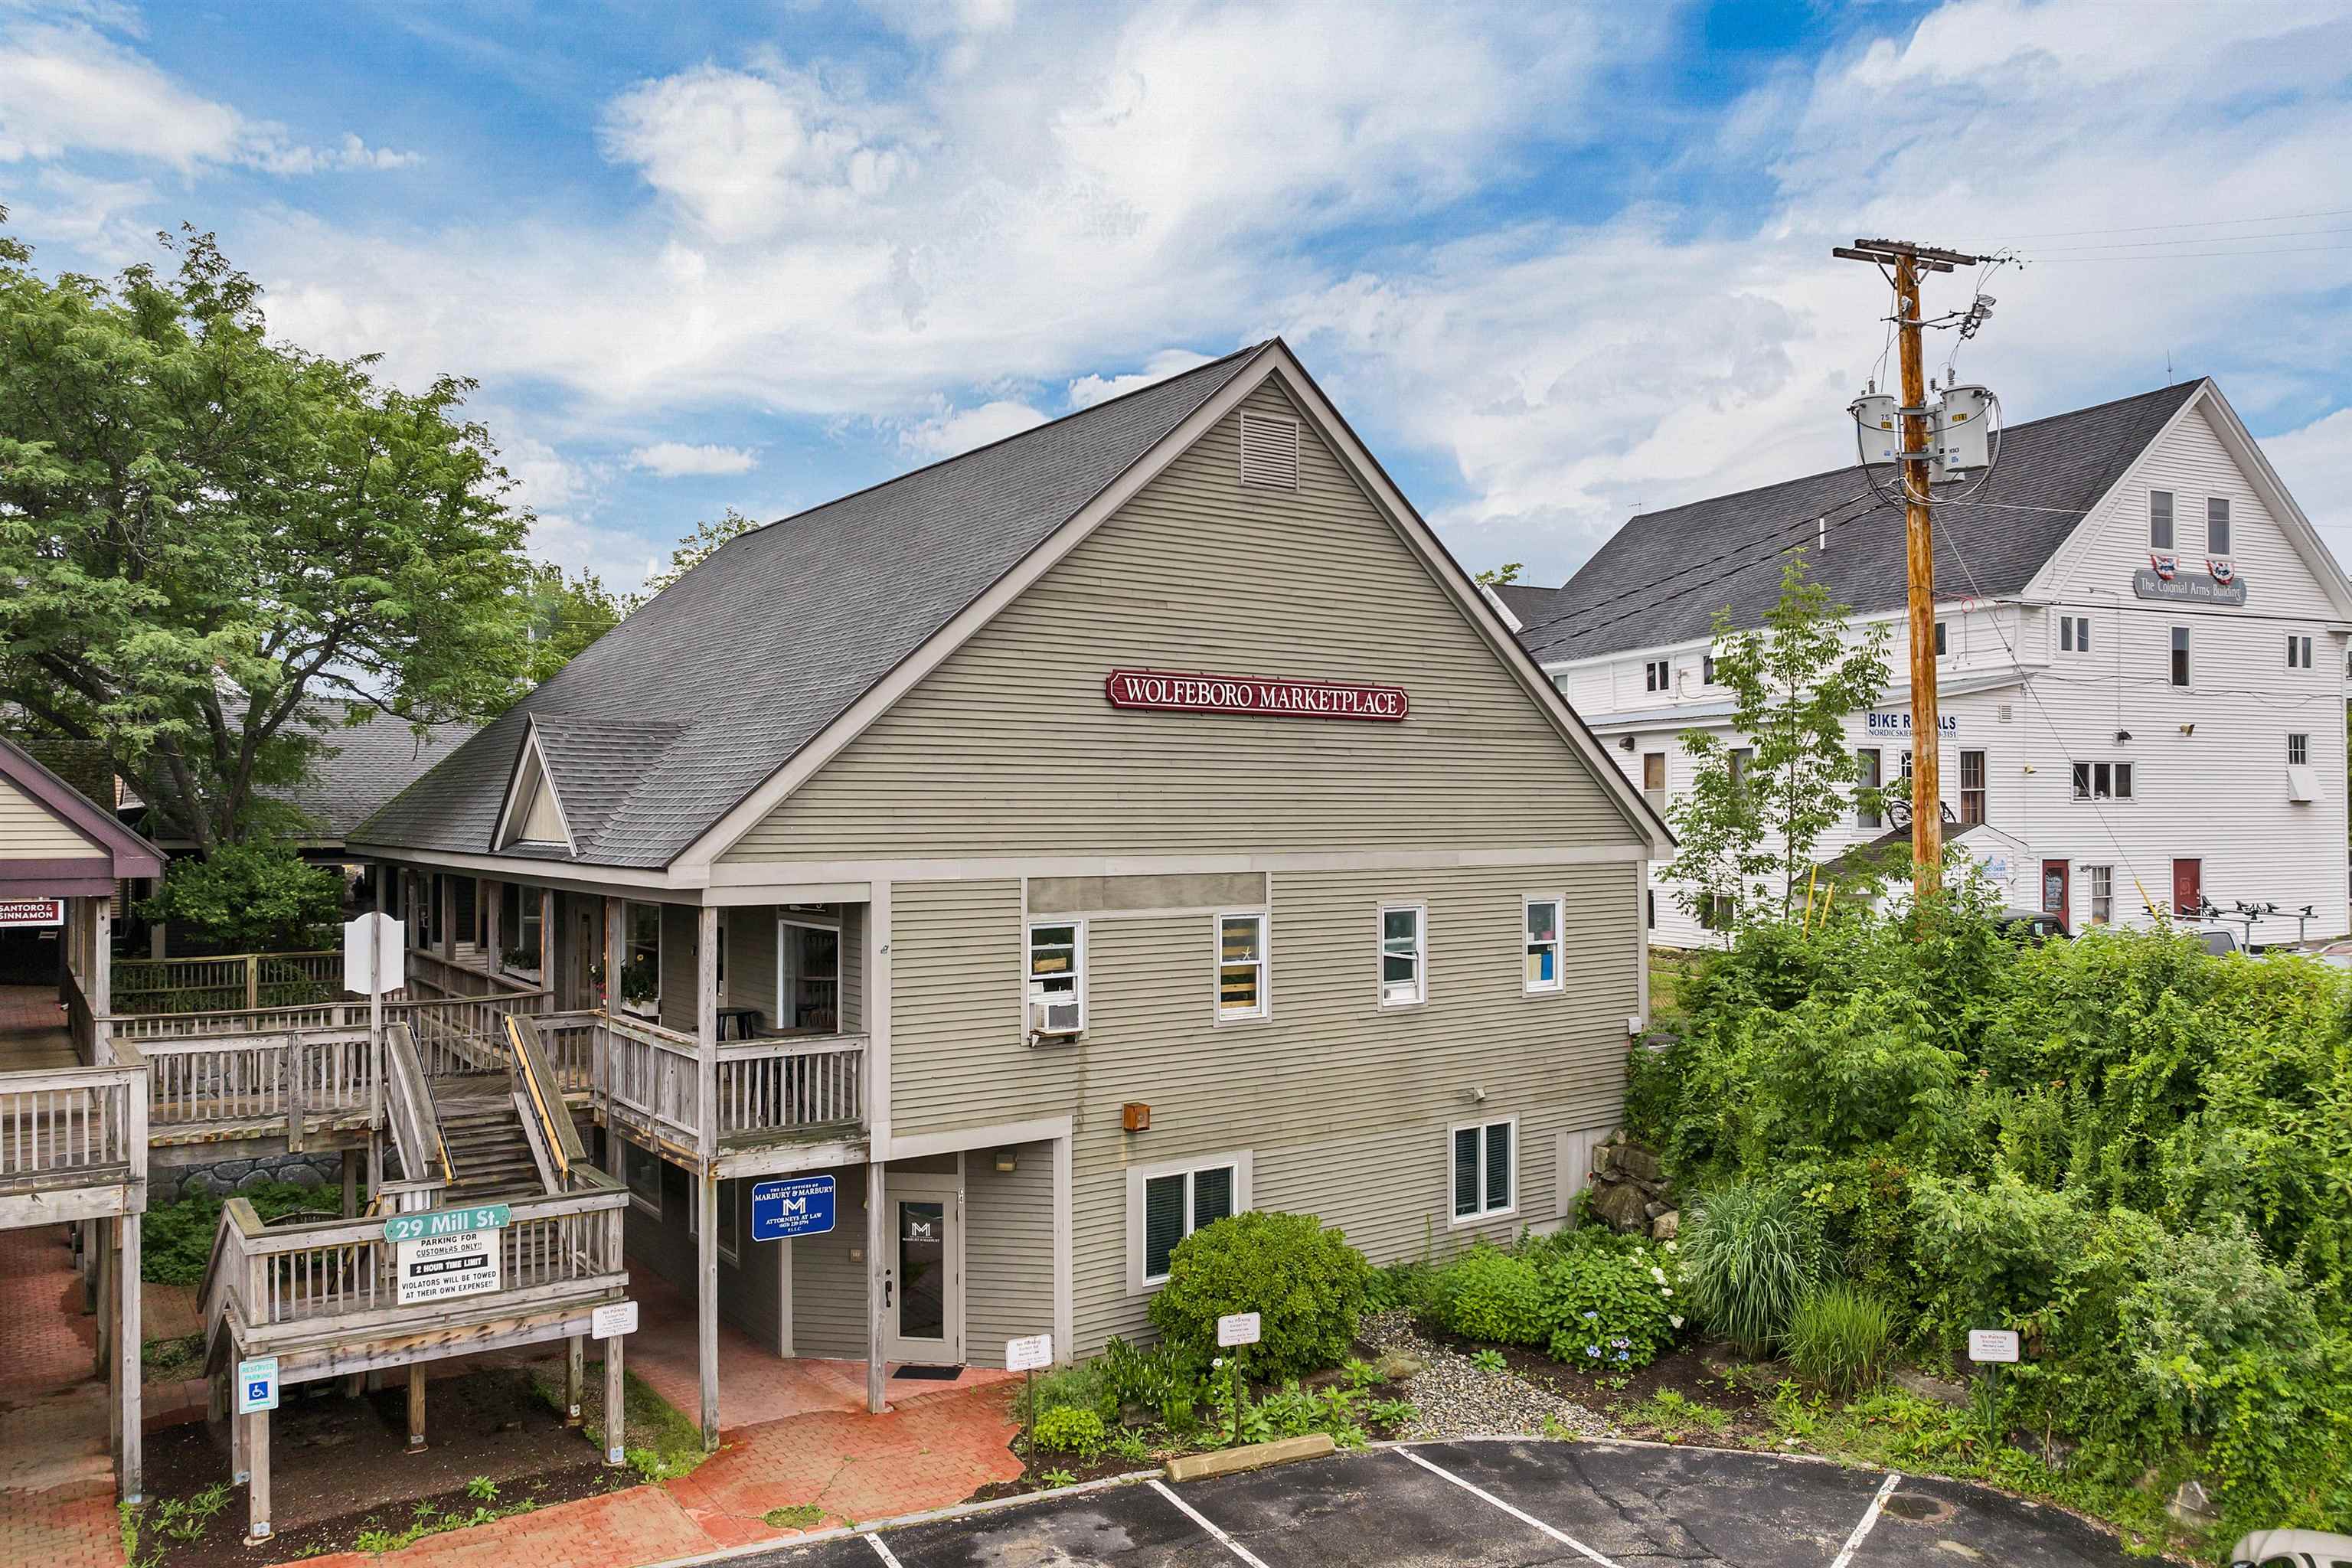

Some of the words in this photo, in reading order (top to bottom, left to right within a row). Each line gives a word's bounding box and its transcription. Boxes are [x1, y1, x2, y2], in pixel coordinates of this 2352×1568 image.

[2141, 578, 2154, 592] The
[2158, 580, 2187, 594] Colonial
[2190, 583, 2210, 596] Arms
[2213, 584, 2240, 601] Building
[1125, 678, 1253, 707] WOLFEBORO
[1259, 686, 1398, 714] MARKETPLACE
[1869, 714, 1898, 728] BIKE
[754, 1191, 791, 1200] MARBURY
[799, 1186, 833, 1195] MARBURY
[782, 1197, 806, 1216] M
[397, 1220, 423, 1238] 29
[431, 1212, 468, 1233] Mill
[477, 1210, 500, 1227] St.
[766, 1216, 799, 1225] ATTORNEYS
[911, 1222, 931, 1236] M
[420, 1236, 457, 1246] PARKING
[416, 1246, 458, 1257] CUSTOMERS
[423, 1263, 444, 1272] HOUR
[446, 1260, 462, 1269] TIME
[464, 1257, 483, 1267] LIMIT
[401, 1279, 440, 1290] VIOLATORS
[473, 1271, 497, 1279] TOWED
[417, 1289, 437, 1297] THEIR
[439, 1286, 456, 1295] OWN
[459, 1282, 494, 1292] EXPENSE!!
